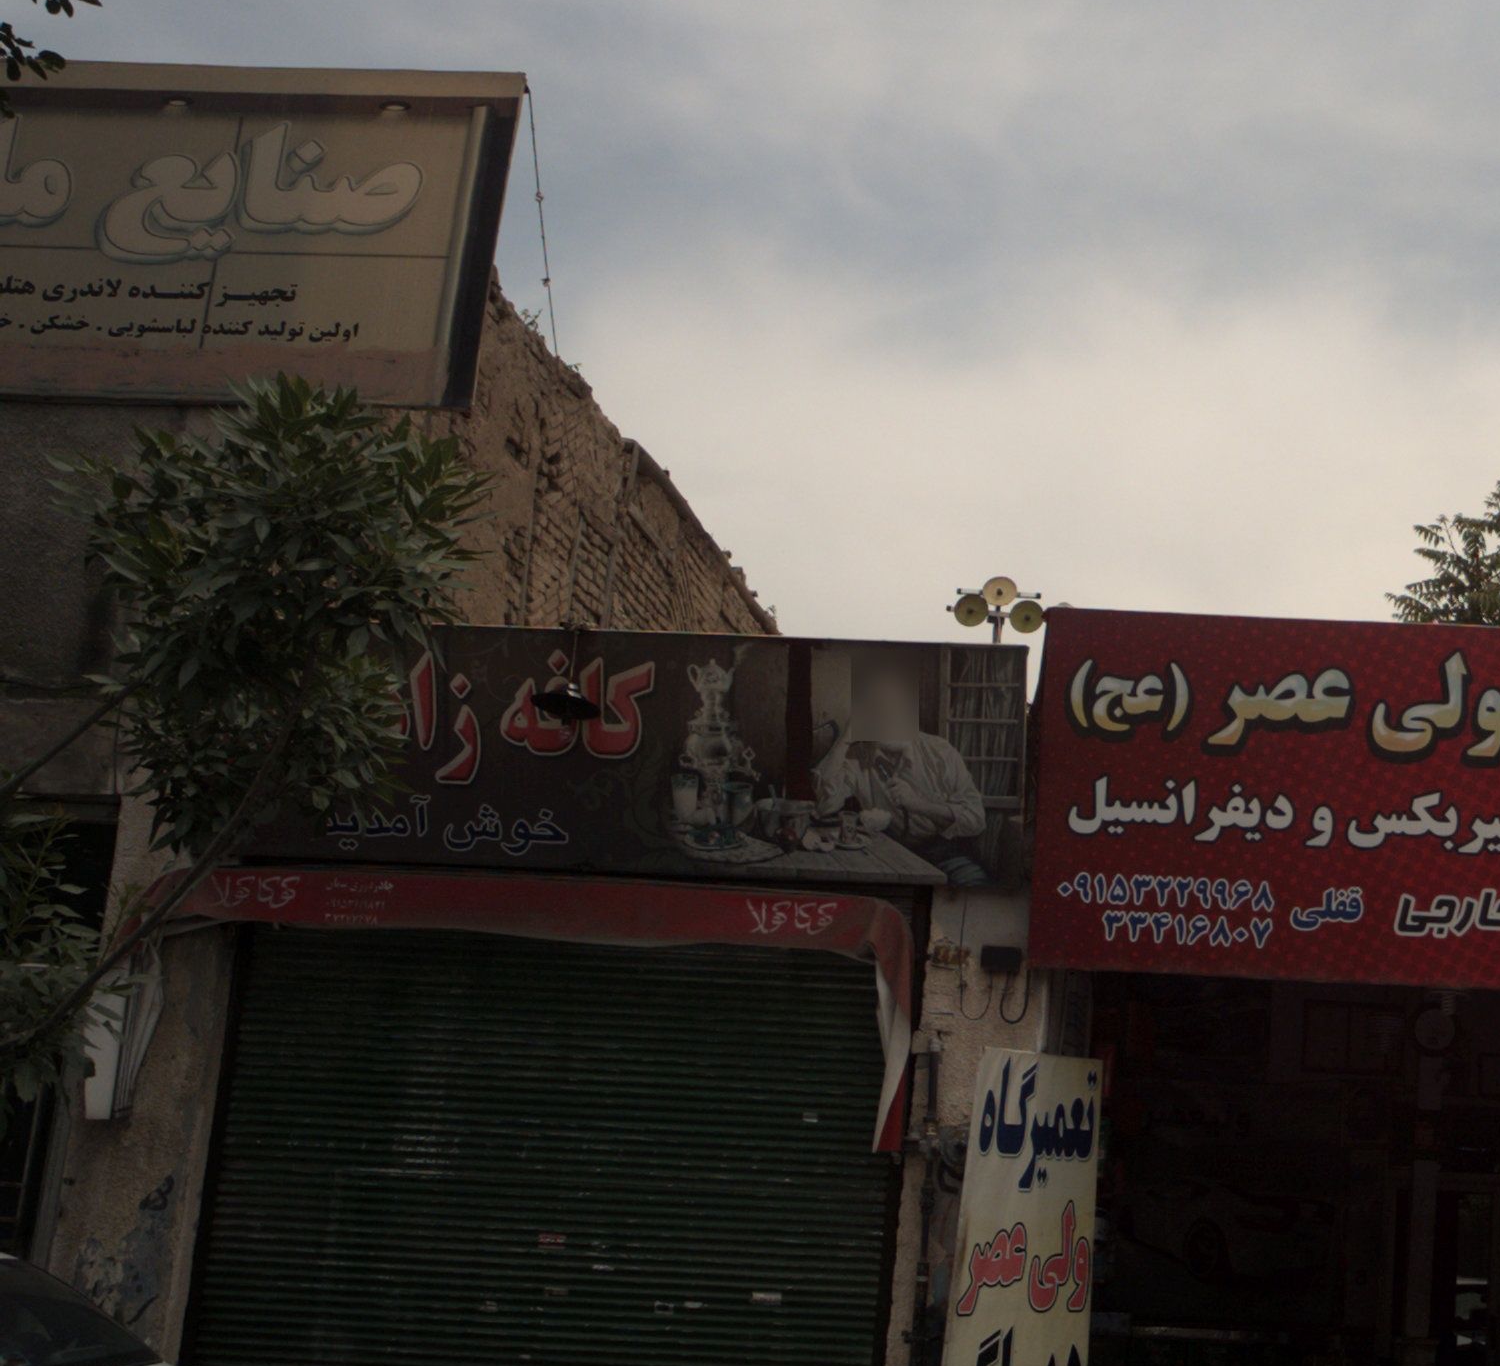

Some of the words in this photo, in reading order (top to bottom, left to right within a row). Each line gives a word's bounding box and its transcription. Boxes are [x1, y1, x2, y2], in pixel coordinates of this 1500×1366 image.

[97, 121, 424, 263] صنایع
[0, 275, 36, 295] هتل
[42, 278, 125, 302] لاندری
[128, 281, 209, 301] کننده
[215, 283, 298, 307] تجهیز
[30, 314, 90, 335] خشکن
[108, 318, 196, 337] لباسشویی
[202, 320, 253, 336] کننده
[258, 319, 304, 339] تولید
[309, 322, 360, 341] اولین
[1206, 667, 1353, 747] عصر
[325, 794, 431, 851] آمدید
[1066, 775, 1296, 843] دیفرانسیل
[443, 803, 569, 856] خوش
[1304, 805, 1335, 848] و
[978, 1057, 1097, 1191] تعمیرگاه
[956, 1222, 1029, 1317] عصر
[1028, 1200, 1090, 1313] ولی
